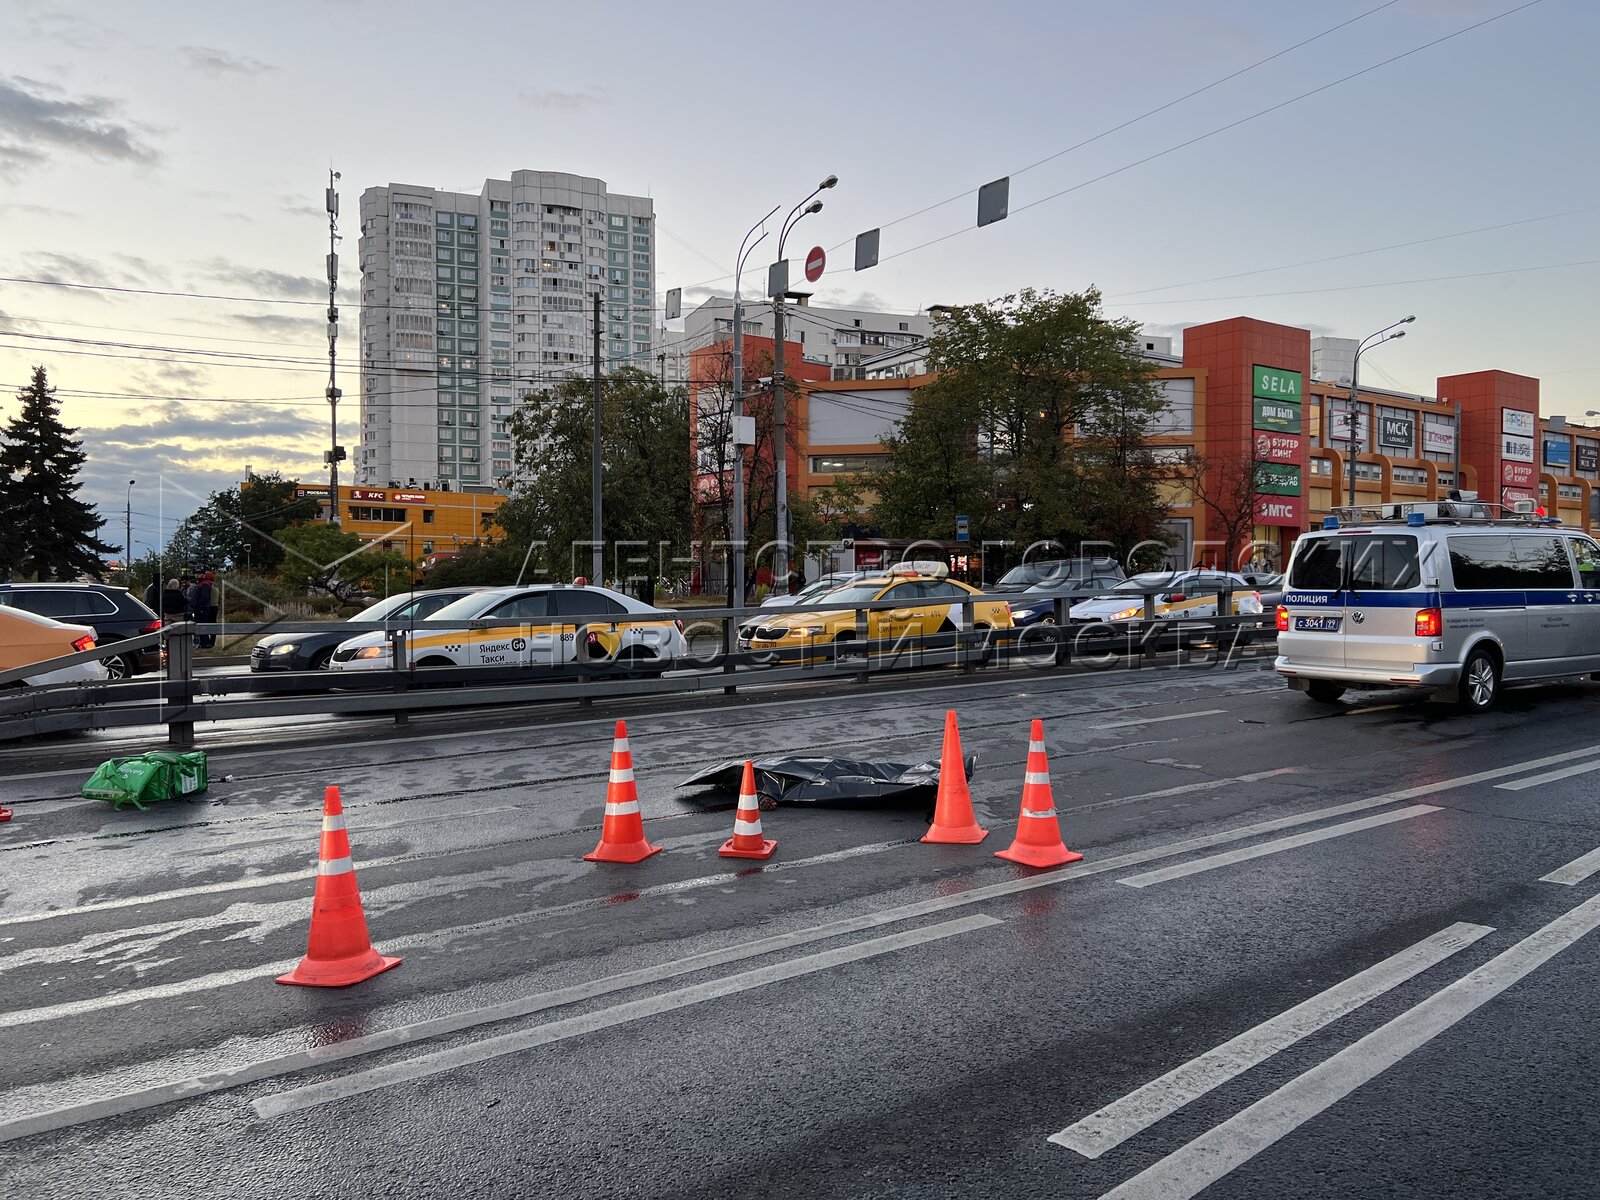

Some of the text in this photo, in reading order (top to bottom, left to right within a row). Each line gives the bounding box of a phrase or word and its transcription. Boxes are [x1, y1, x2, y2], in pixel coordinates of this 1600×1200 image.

[1261, 375, 1295, 394] SELA
[1262, 405, 1294, 420] ДОМ БЫТА
[1272, 438, 1299, 449] БУРГЕР
[1389, 436, 1406, 444] LOUNGE
[1272, 448, 1293, 459] КИНГ
[1514, 466, 1532, 475] БУРГЕР
[1514, 475, 1527, 483] КИНГ
[1268, 504, 1293, 518] МТС
[1285, 594, 1328, 604] ПОЛИЦИЯ
[1304, 618, 1324, 628] 3041
[1327, 619, 1336, 627] 99
[559, 633, 575, 642] 889
[479, 640, 526, 653] Яндекс Go
[481, 655, 505, 664] Такси
